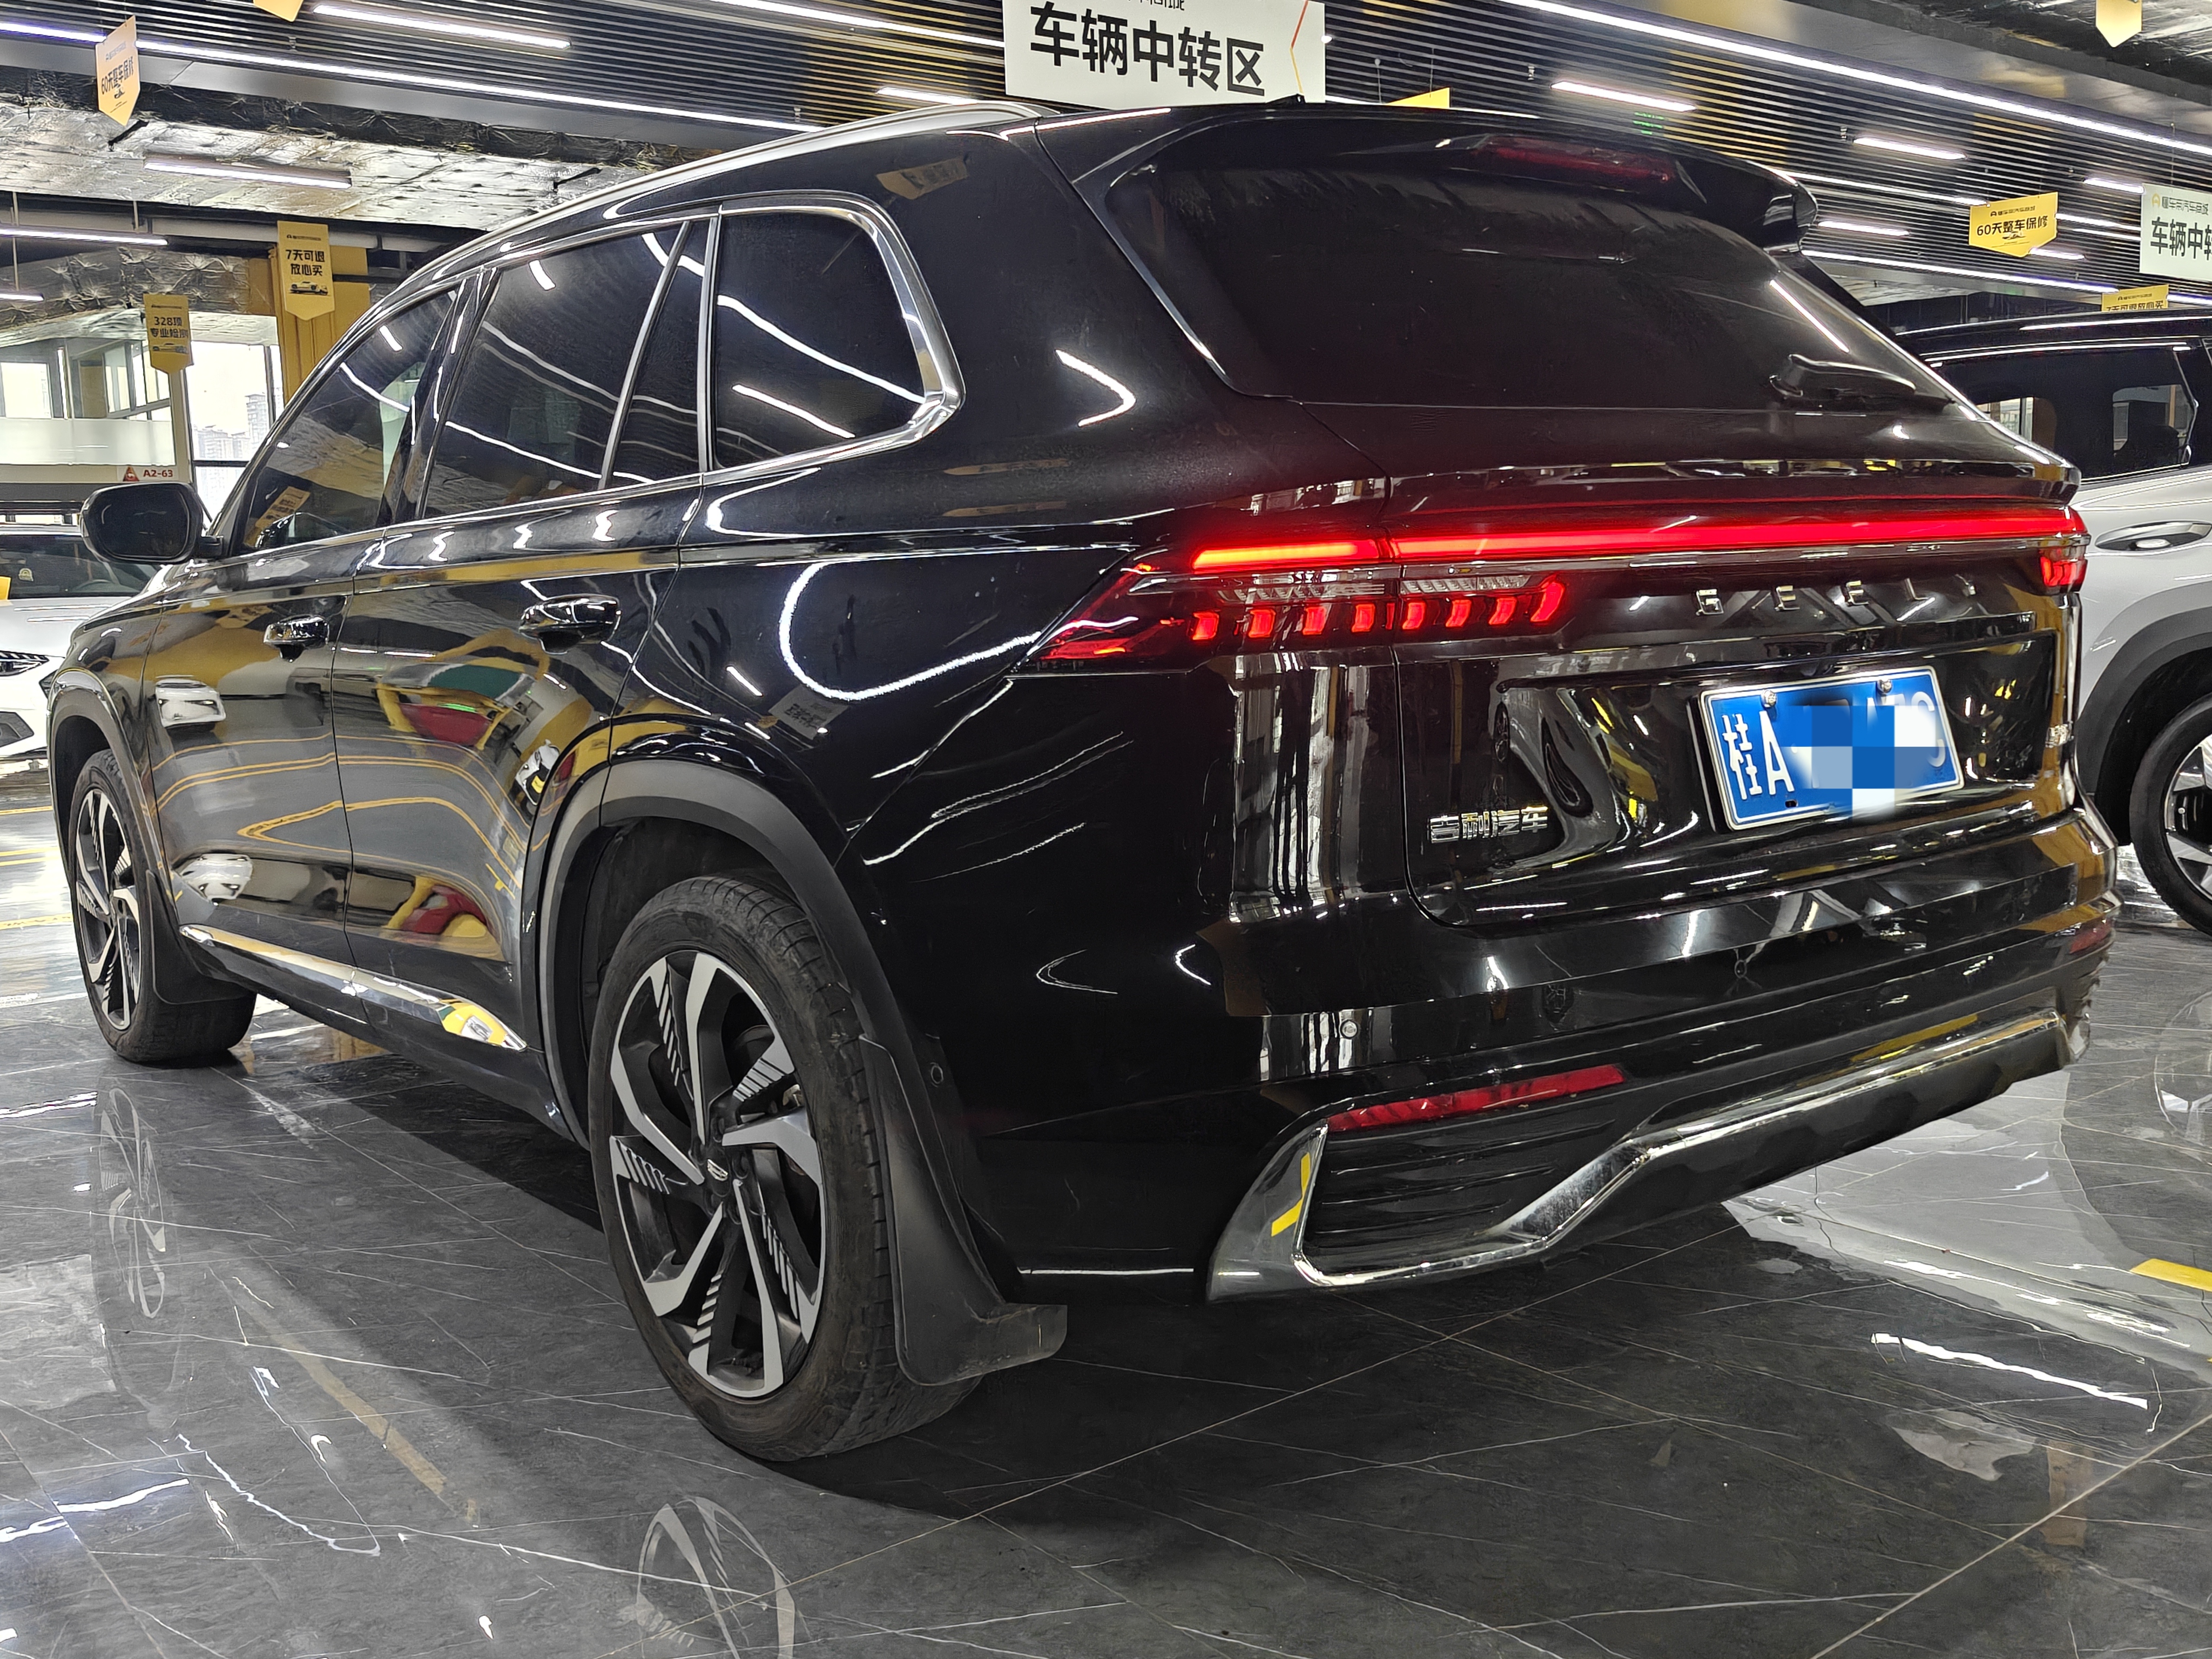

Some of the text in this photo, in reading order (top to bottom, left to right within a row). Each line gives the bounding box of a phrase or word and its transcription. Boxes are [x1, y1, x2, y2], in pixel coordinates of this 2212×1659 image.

[1030, 1, 1265, 96] 车辆中转区
[102, 56, 134, 95] 60天整车保修
[1977, 215, 2048, 236] 60天整车保修
[285, 249, 325, 262] 7天可退
[291, 263, 322, 276] 放心买
[154, 316, 183, 326] 328项
[143, 469, 173, 477] A2-63
[1430, 805, 1548, 844] 吉利汽车
